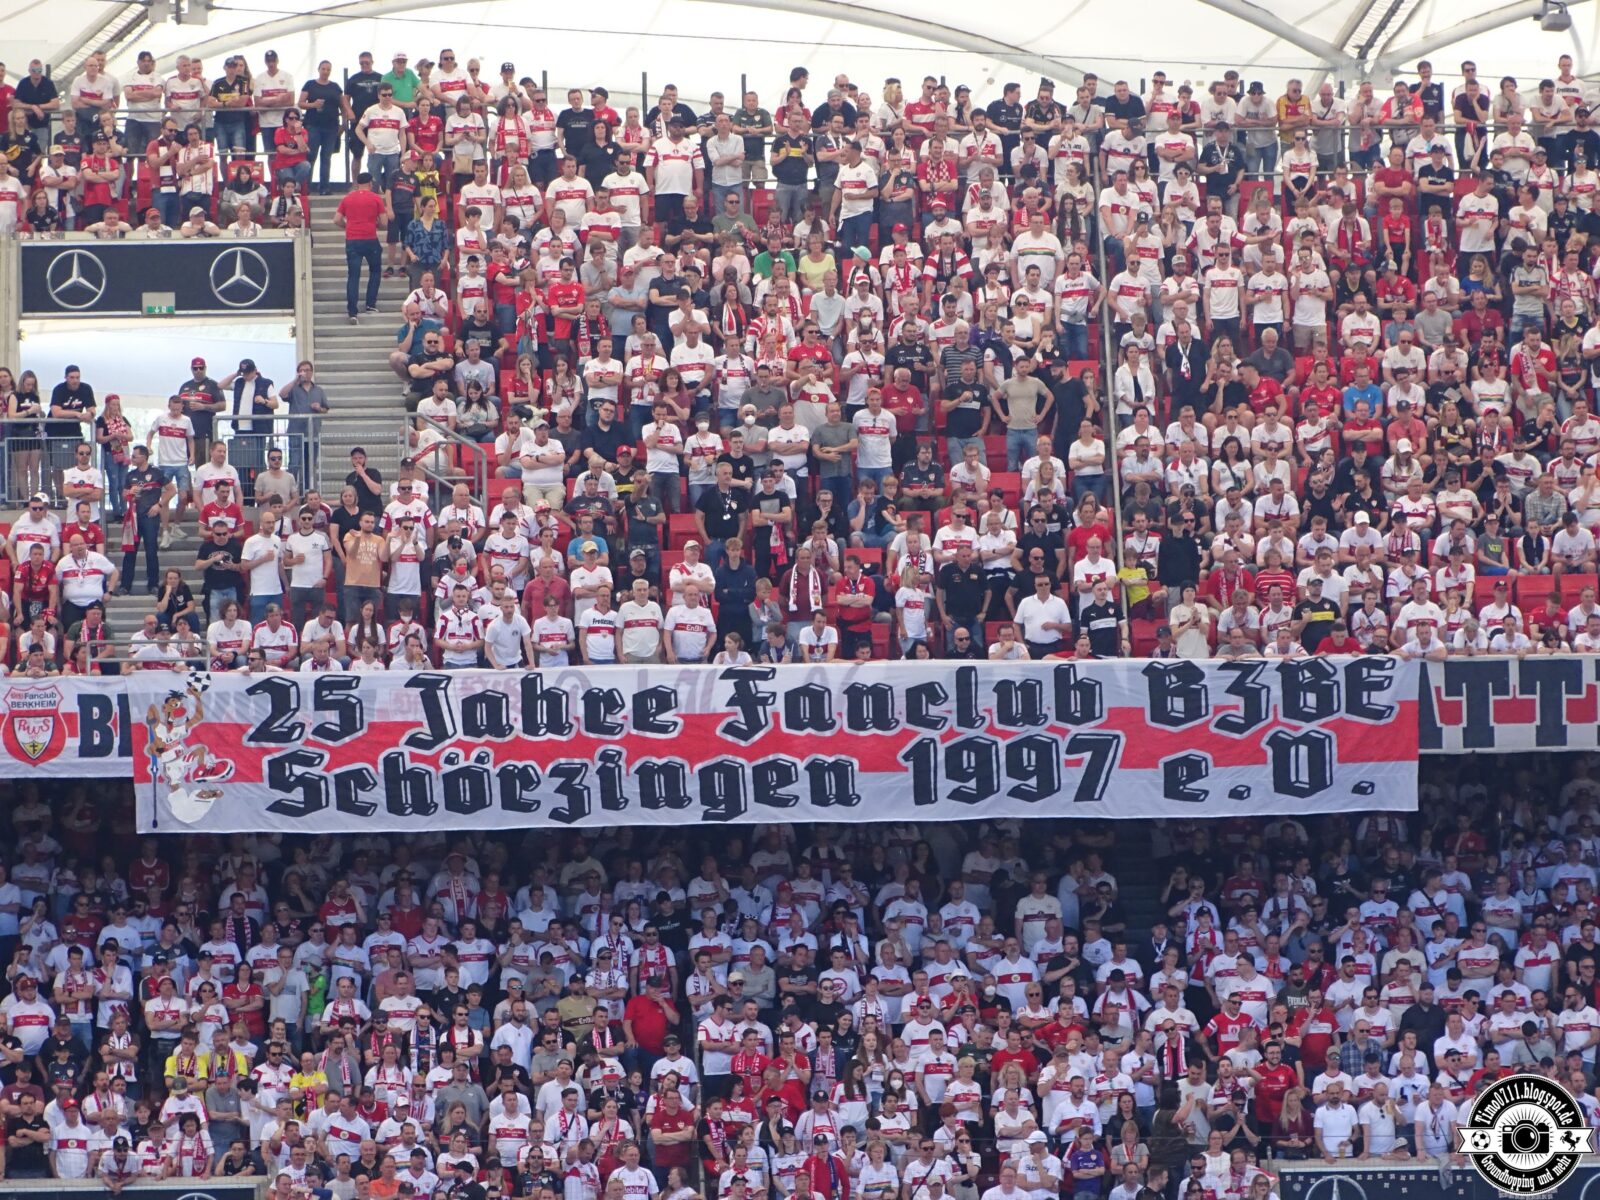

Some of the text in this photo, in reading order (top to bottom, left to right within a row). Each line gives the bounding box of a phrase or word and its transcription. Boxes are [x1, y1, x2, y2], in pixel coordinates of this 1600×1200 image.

[11, 700, 56, 709] BERKHEIM
[24, 692, 57, 700] Fanclub
[245, 675, 364, 744] 25
[404, 674, 678, 751] Jahre
[719, 666, 1103, 742] Fanclub
[1418, 661, 1600, 749] TT
[18, 718, 51, 735] RWS
[266, 749, 861, 824] Schörzingen
[902, 733, 1121, 807] 1997
